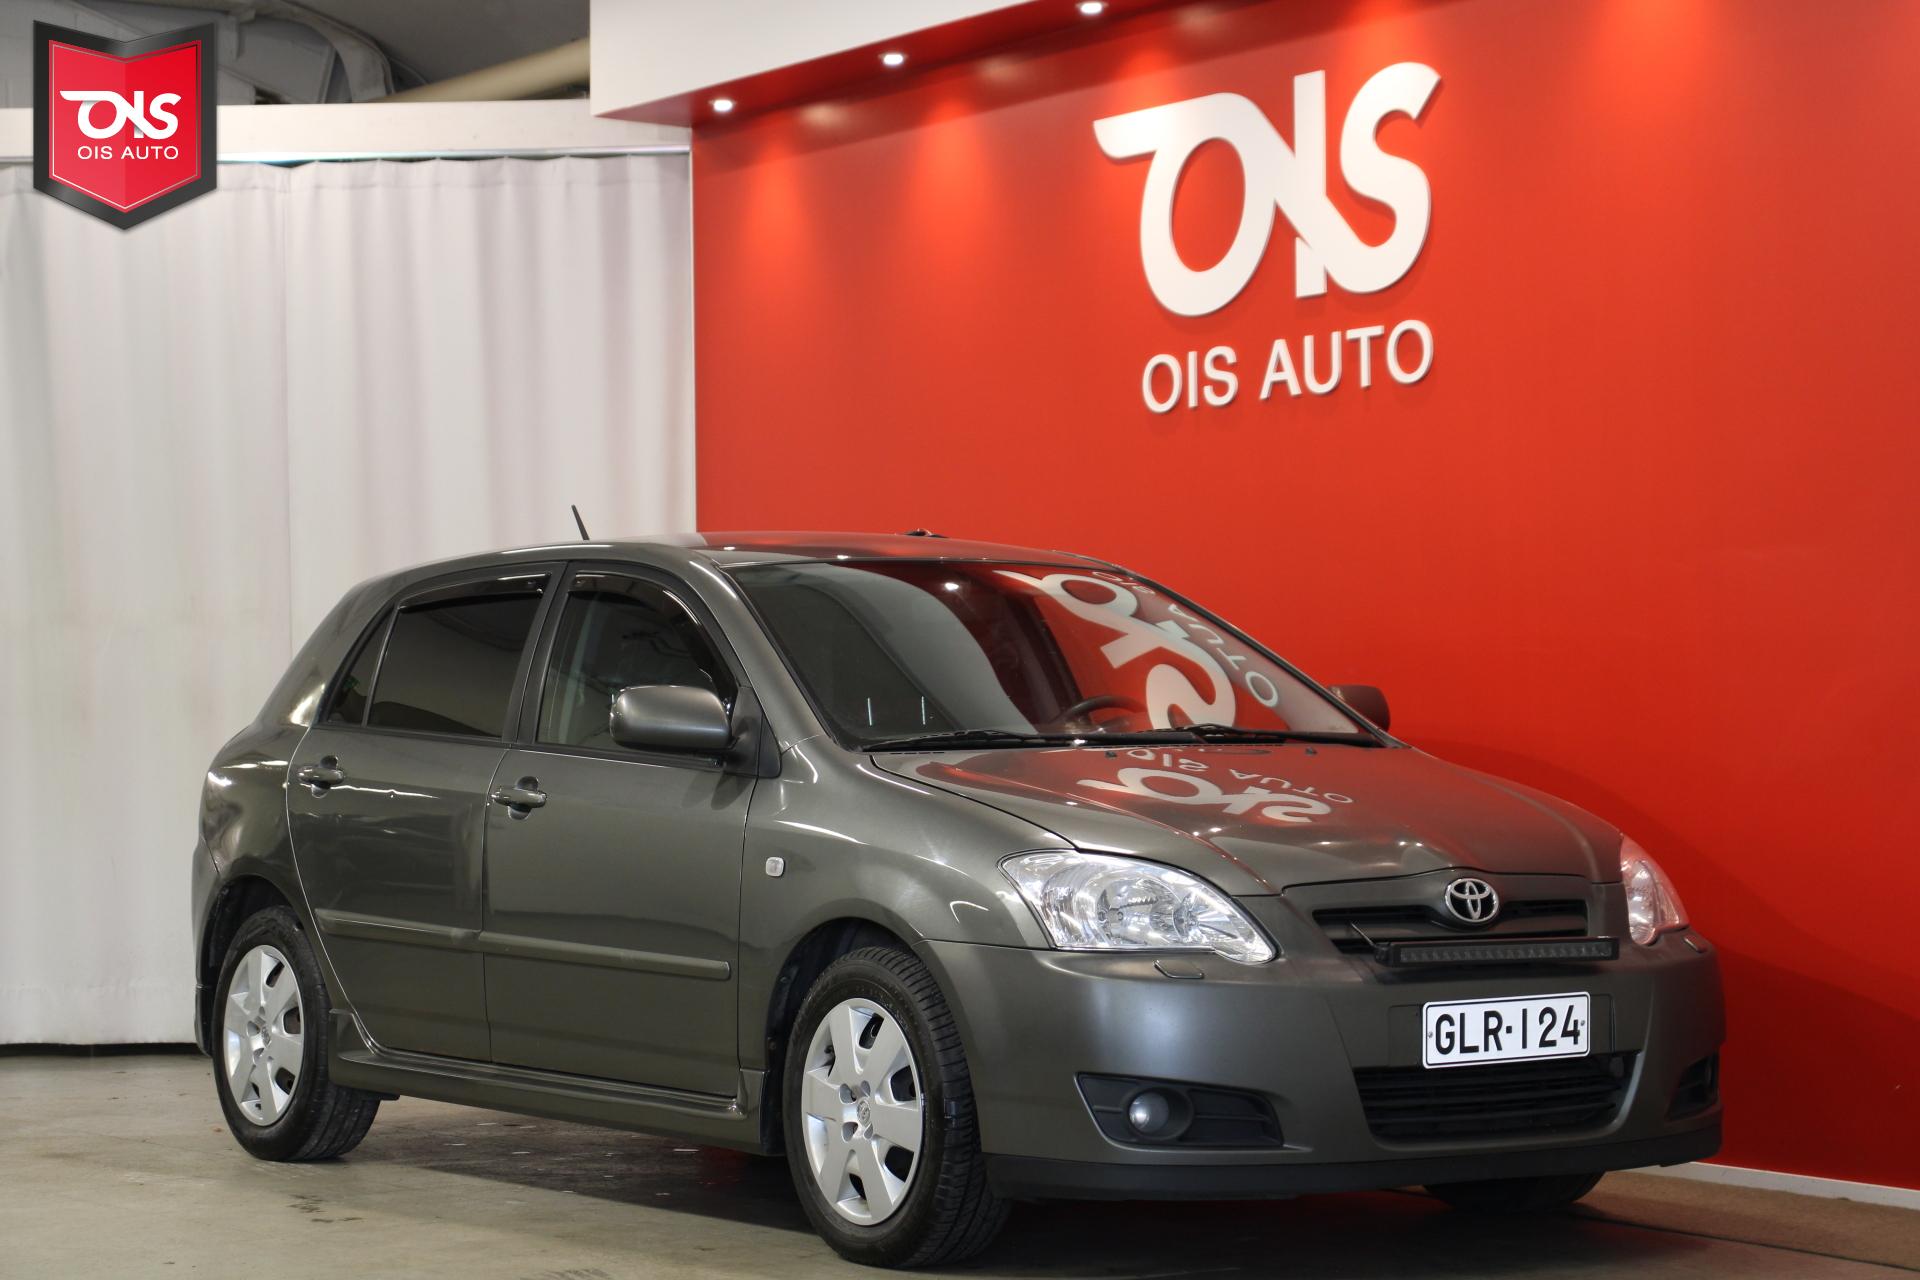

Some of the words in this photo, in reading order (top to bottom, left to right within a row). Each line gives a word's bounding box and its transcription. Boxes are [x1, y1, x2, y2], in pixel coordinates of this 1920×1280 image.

[1093, 62, 1441, 317] OIS
[1141, 345, 1239, 414] OIS
[1259, 319, 1435, 401] AUTO
